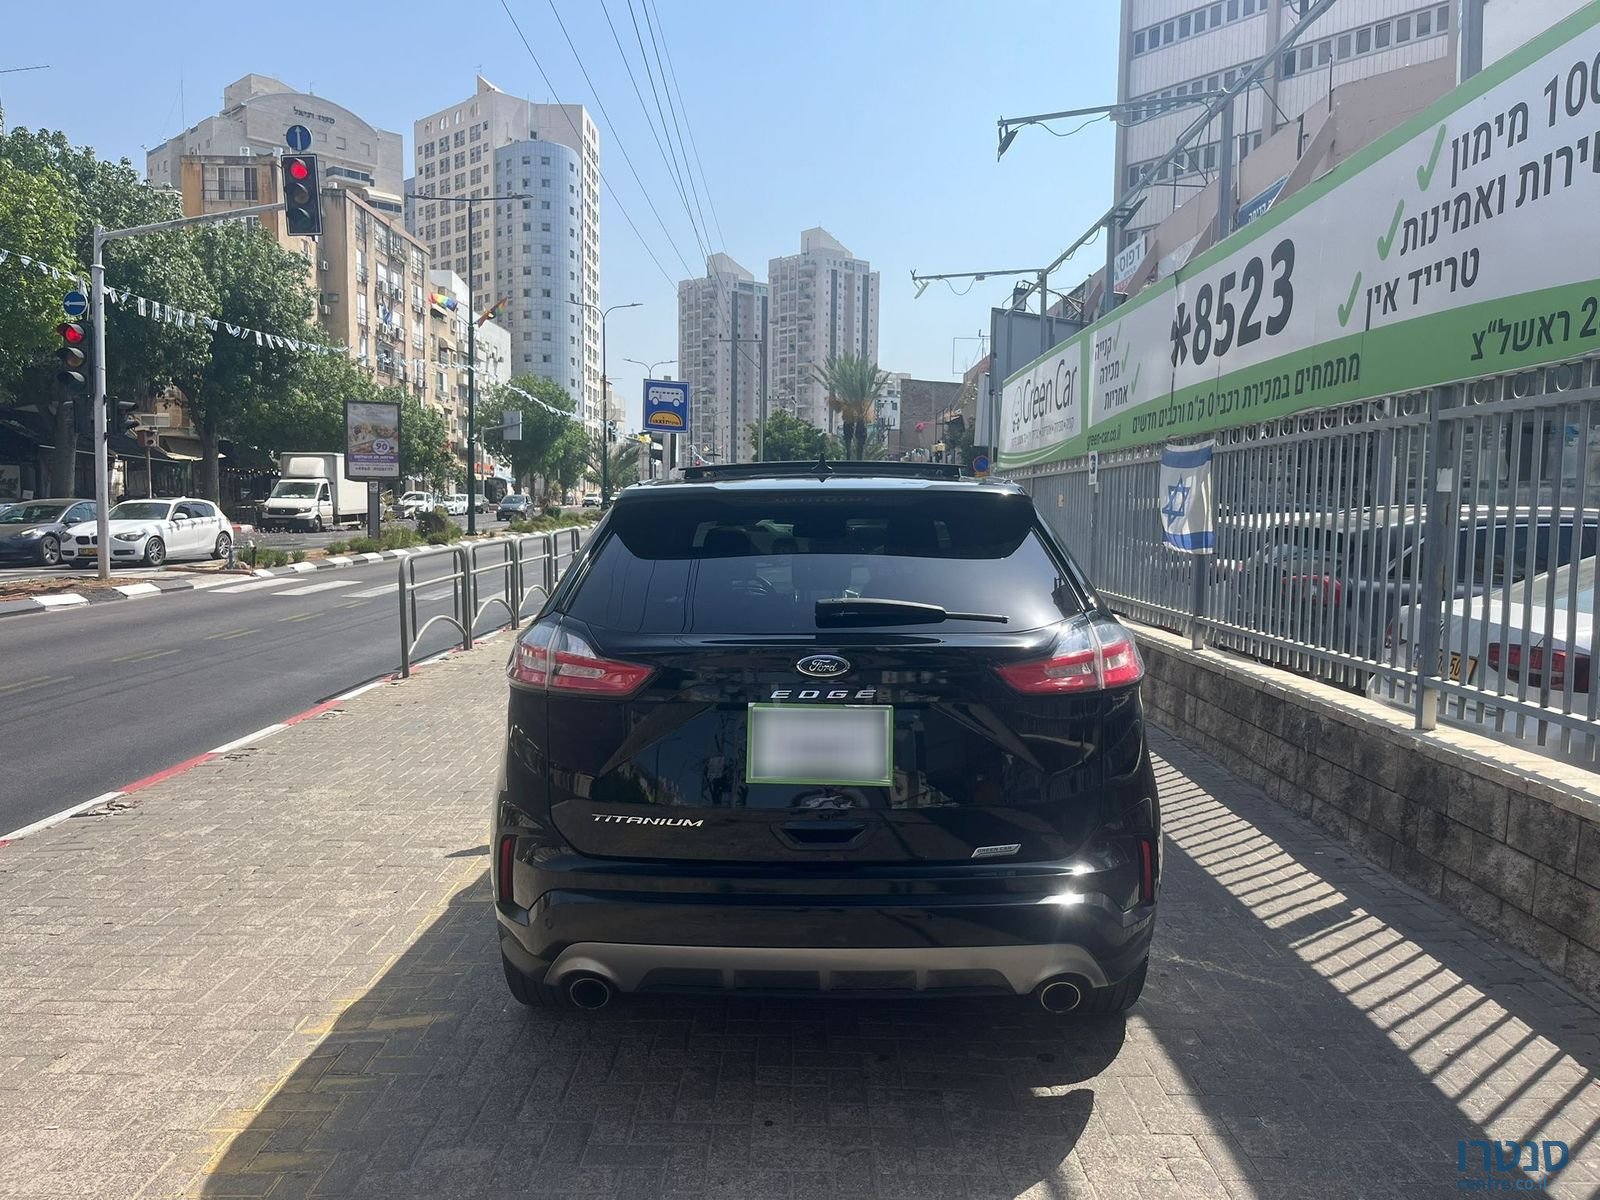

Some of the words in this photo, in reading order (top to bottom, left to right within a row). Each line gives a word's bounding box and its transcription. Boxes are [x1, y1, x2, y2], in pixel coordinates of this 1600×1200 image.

[1451, 101, 1529, 189] מימון
[1400, 174, 1506, 257] ואמינות
[1407, 247, 1480, 306] טרייד
[1365, 276, 1400, 331] אין
[1579, 296, 1600, 338] 2
[1099, 360, 1120, 384] מכירה
[1294, 352, 1360, 396] מתמחים
[1022, 378, 1053, 424] Green
[1055, 359, 1078, 411] Car
[1104, 384, 1129, 410] אחריות
[1217, 389, 1240, 415] רכבי
[1242, 374, 1290, 409] במכירת
[1132, 411, 1157, 434] חדשים
[1159, 403, 1186, 428] ורכבים
[375, 442, 387, 450] 90
[808, 659, 839, 672] Ford
[770, 689, 877, 699] EDGE
[591, 813, 704, 827] TITANIUM
